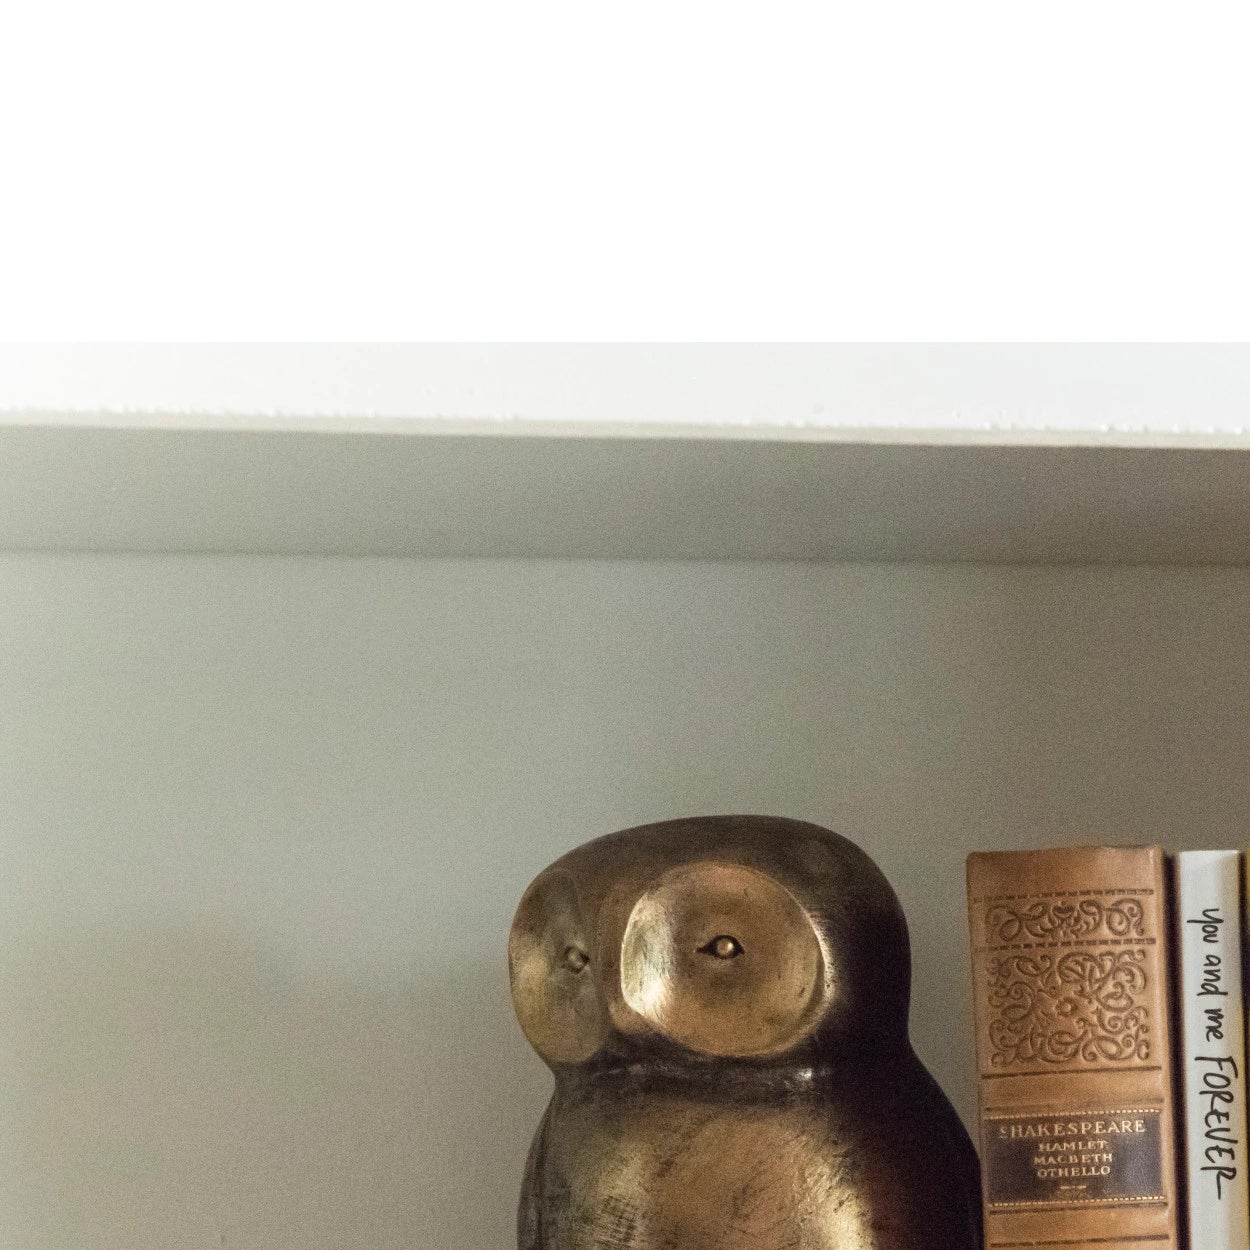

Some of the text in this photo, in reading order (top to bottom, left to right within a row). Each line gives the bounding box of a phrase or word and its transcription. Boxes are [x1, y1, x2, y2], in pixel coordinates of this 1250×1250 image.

[1187, 908, 1239, 1200] you and me FOREVER
[1000, 1119, 1147, 1140] SHAKESPEARE
[1034, 1153, 1113, 1166] MACBETH
[1037, 1165, 1111, 1178] OTHELLO
